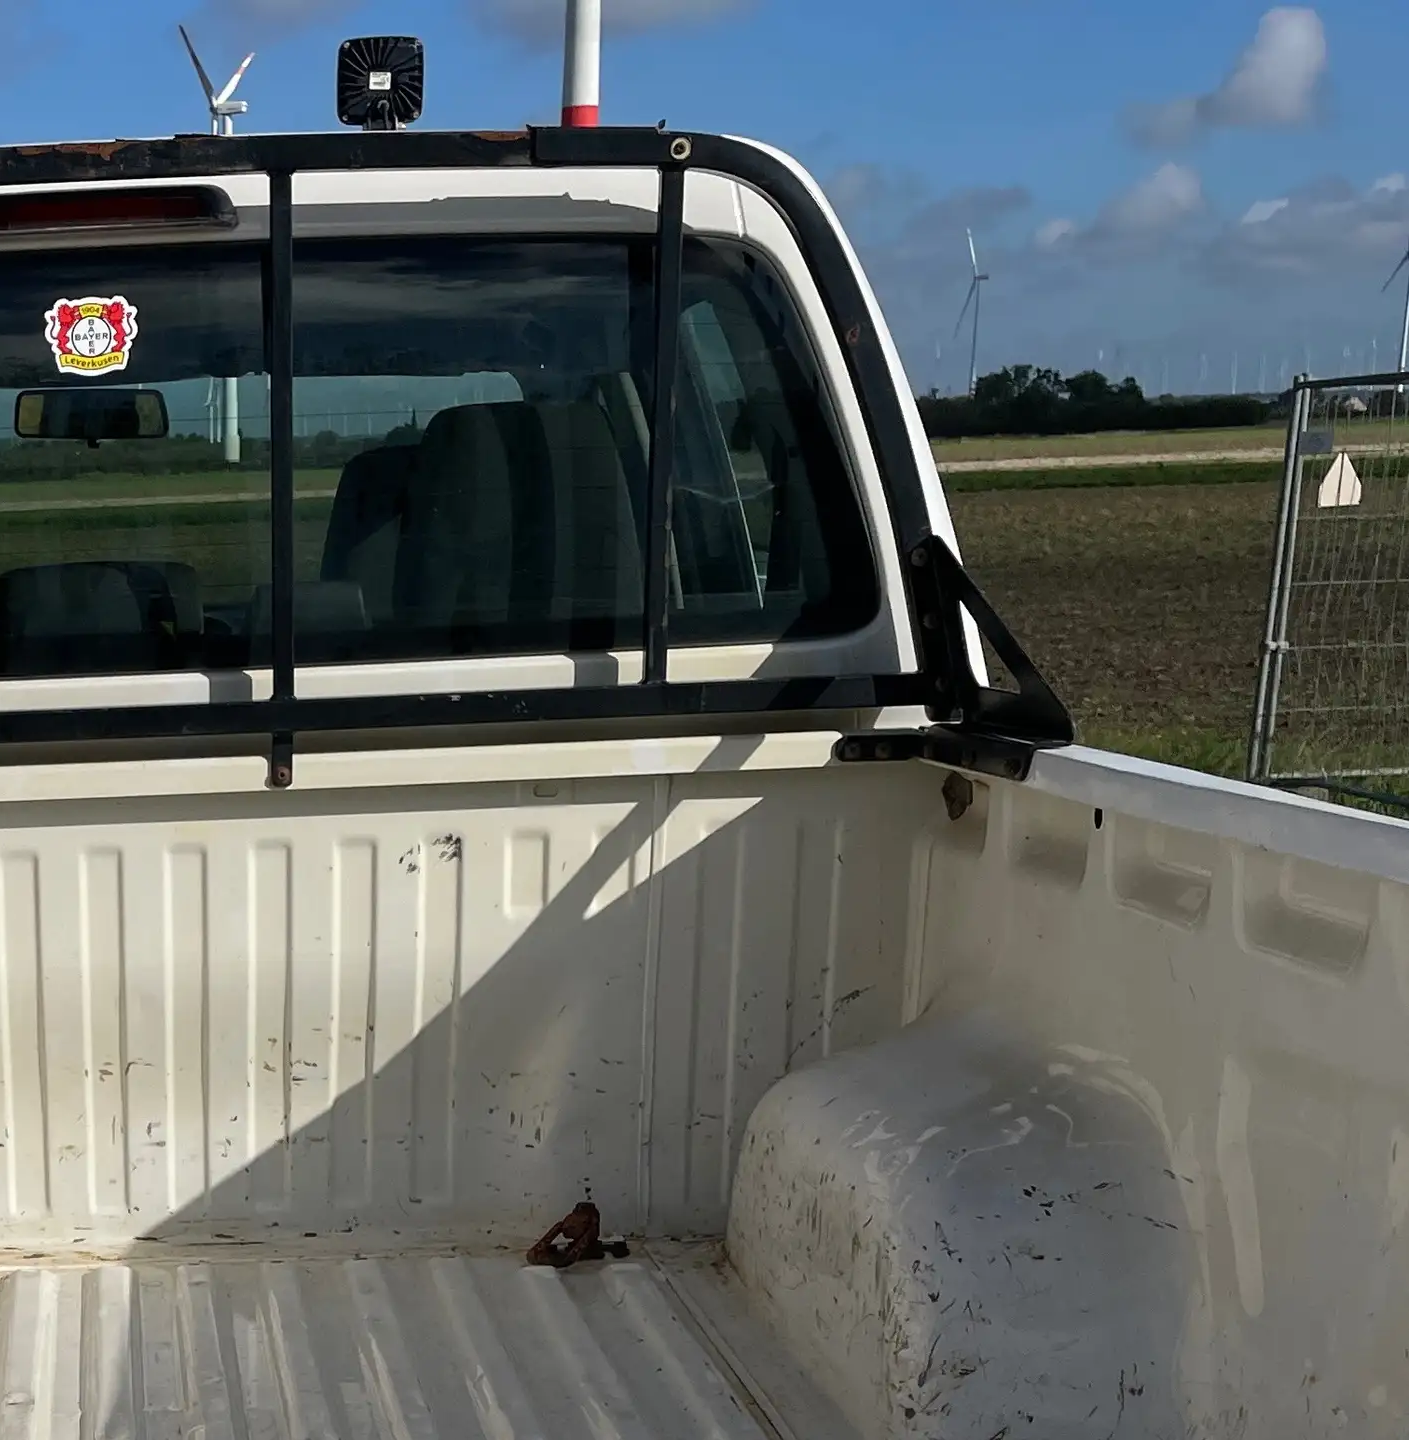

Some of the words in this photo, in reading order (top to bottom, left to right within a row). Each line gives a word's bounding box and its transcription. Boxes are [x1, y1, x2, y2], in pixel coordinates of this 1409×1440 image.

[74, 332, 109, 341] BAYER
[87, 319, 96, 354] BAYER
[64, 355, 120, 368] Leverkusen
